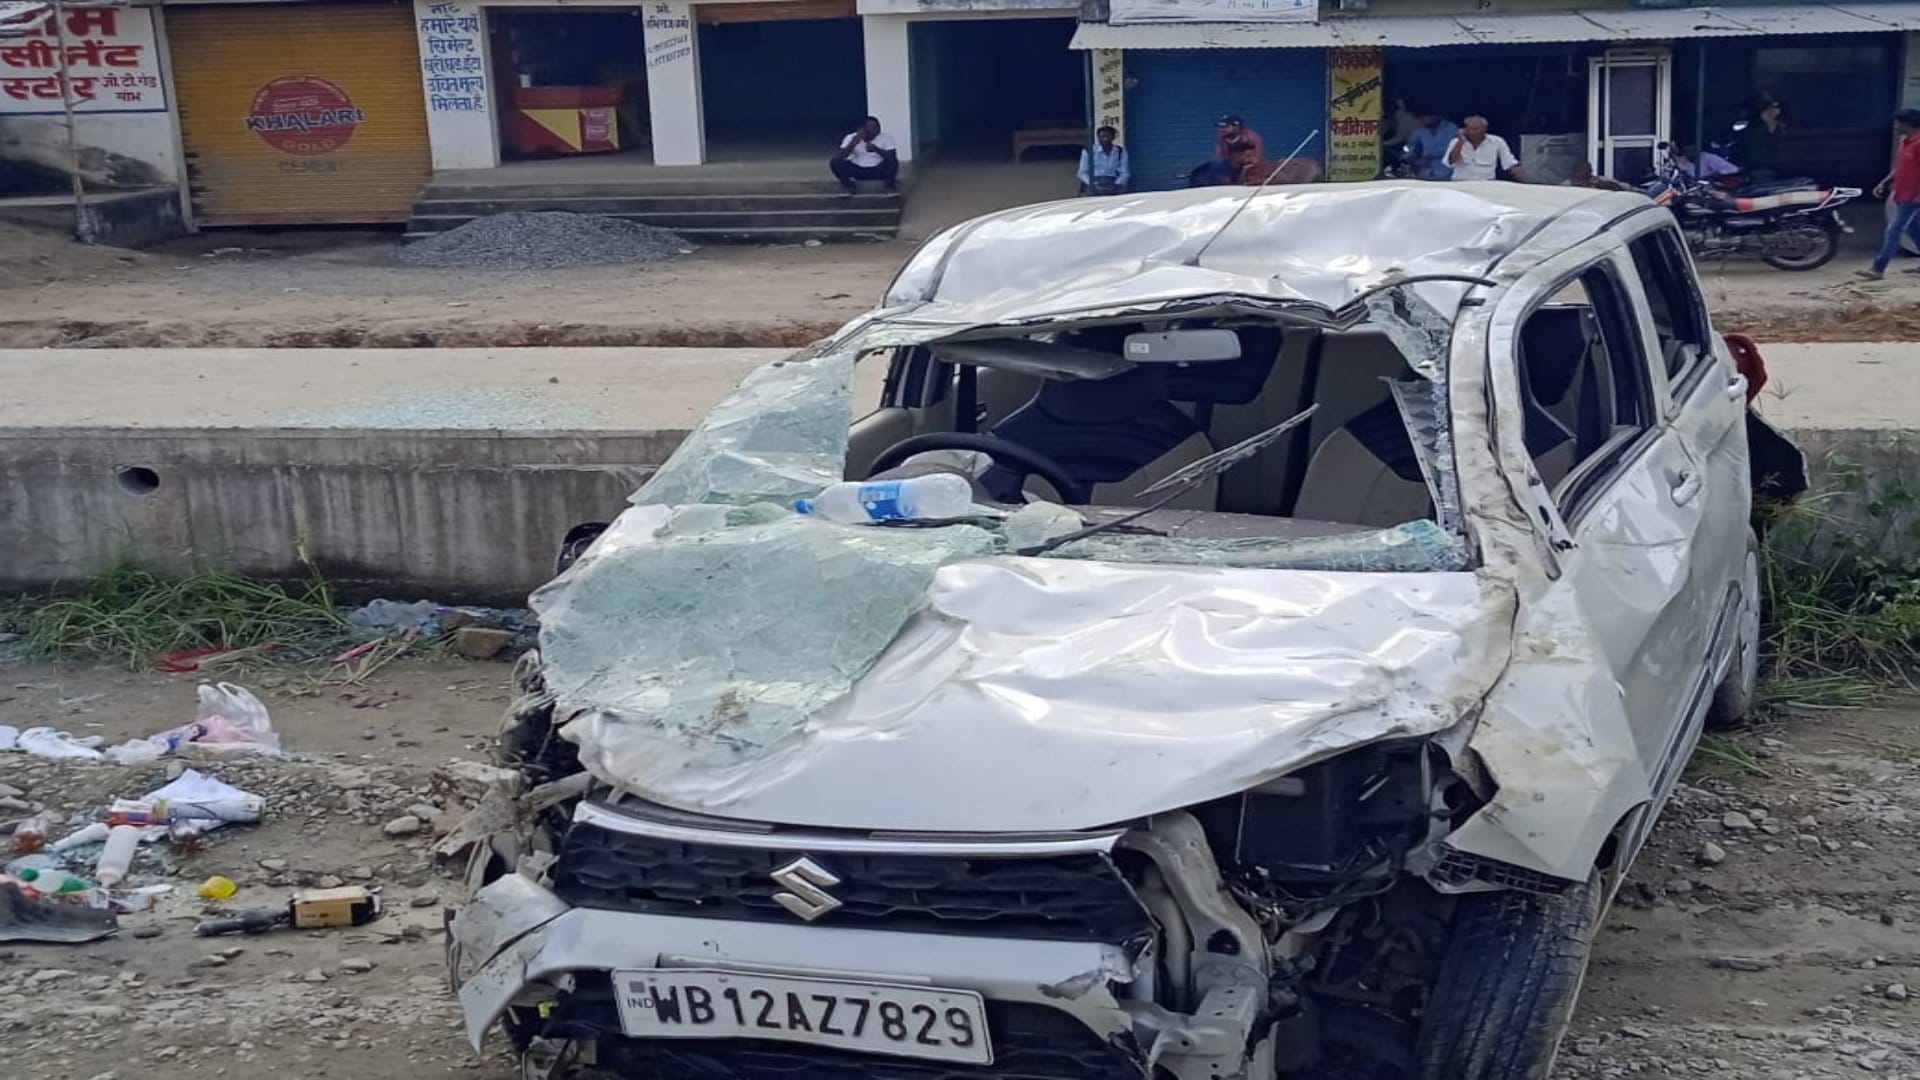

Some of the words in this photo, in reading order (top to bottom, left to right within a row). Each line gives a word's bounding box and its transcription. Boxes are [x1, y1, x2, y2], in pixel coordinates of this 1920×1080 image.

[245, 107, 364, 133] KHALARI
[626, 997, 655, 1009] IND
[649, 985, 975, 1048] WB12AZ7829
